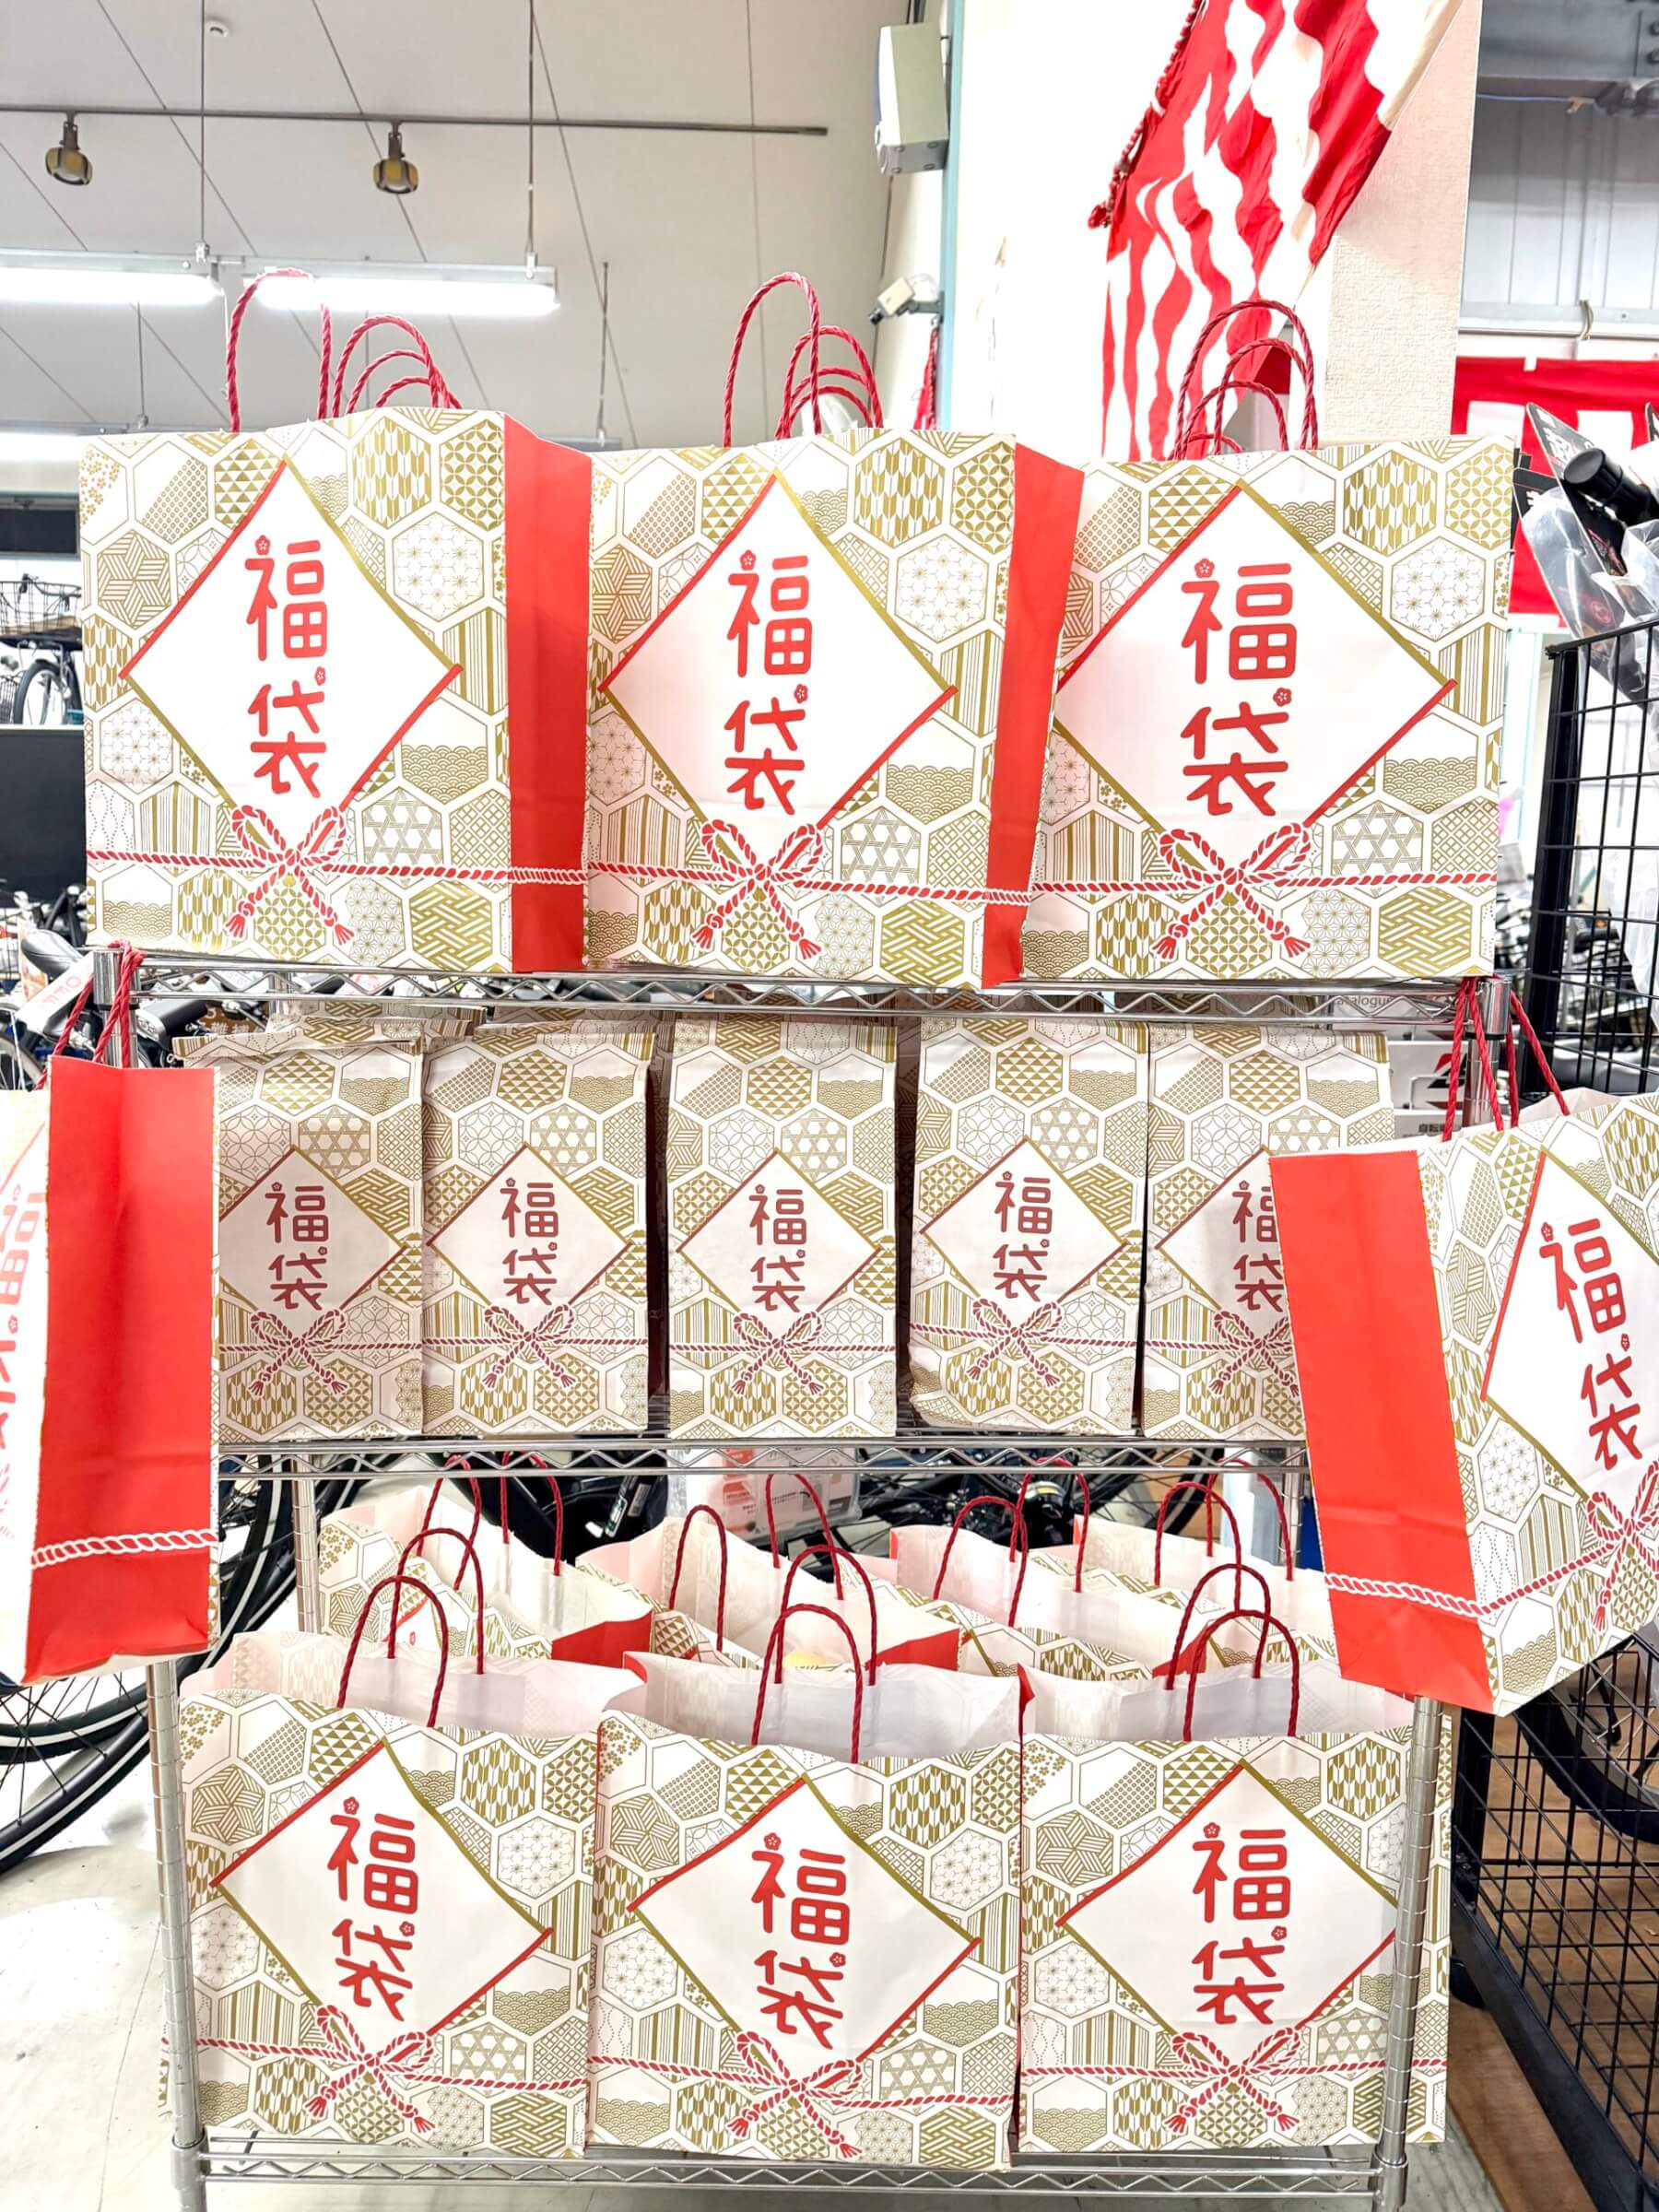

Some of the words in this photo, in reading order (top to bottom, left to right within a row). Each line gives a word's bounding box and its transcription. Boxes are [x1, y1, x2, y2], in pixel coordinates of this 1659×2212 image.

[244, 535, 328, 798] 福袋
[726, 549, 813, 817] 福袋
[1180, 558, 1298, 818] 福袋
[265, 1182, 329, 1310] 福袋
[500, 1177, 559, 1304] 福袋
[749, 1183, 807, 1312] 福袋
[993, 1170, 1053, 1301] 福袋
[1232, 1181, 1284, 1312] 福袋
[1538, 1218, 1643, 1471] 福袋
[327, 1796, 419, 2022] 福袋
[751, 1831, 852, 2051] 福袋
[1192, 1822, 1291, 2026] 福袋
